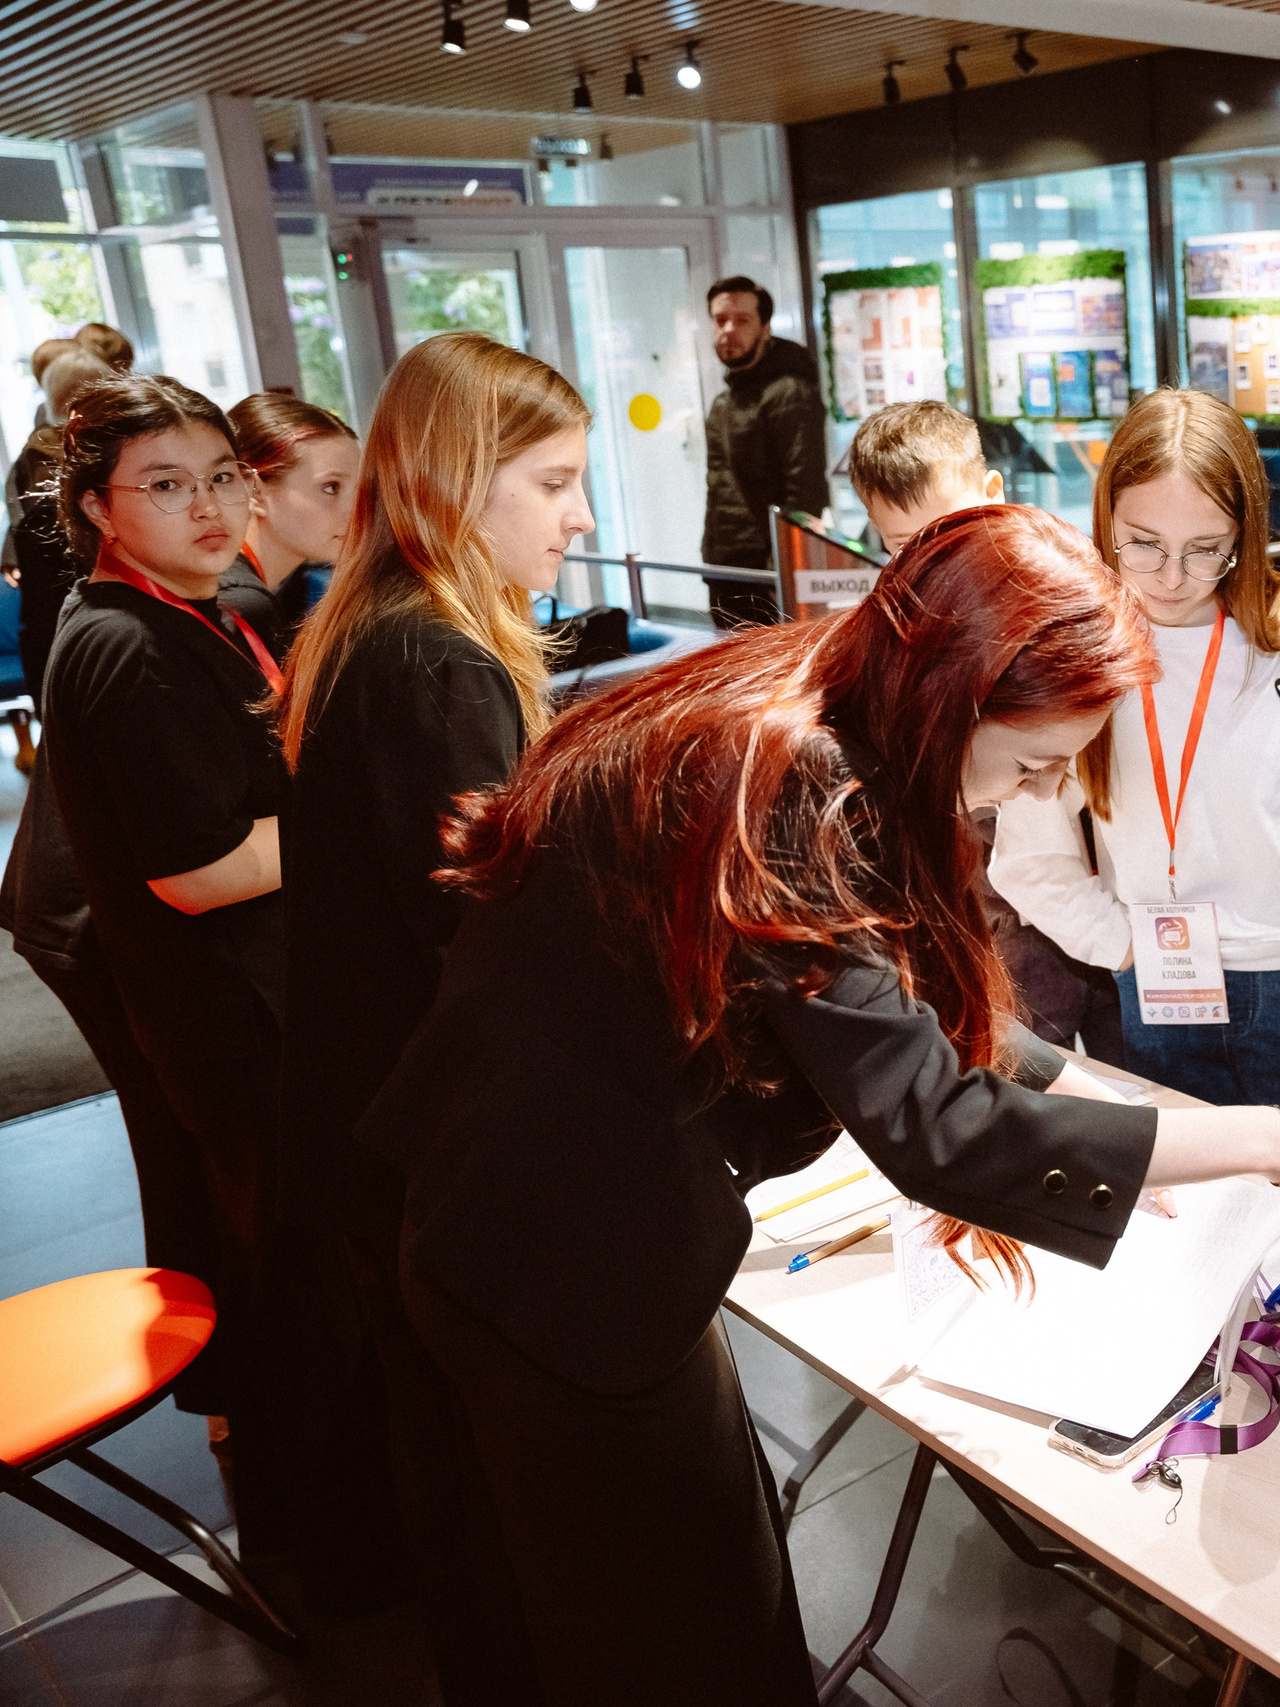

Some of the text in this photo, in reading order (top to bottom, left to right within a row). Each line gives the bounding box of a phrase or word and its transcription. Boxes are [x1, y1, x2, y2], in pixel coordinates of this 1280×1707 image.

[811, 579, 870, 593] ВЫХОД
[1147, 906, 1165, 914] БЕЛАЯ
[1163, 956, 1192, 966] ПОЛИНА
[1162, 970, 1196, 980] КЛАДОВА
